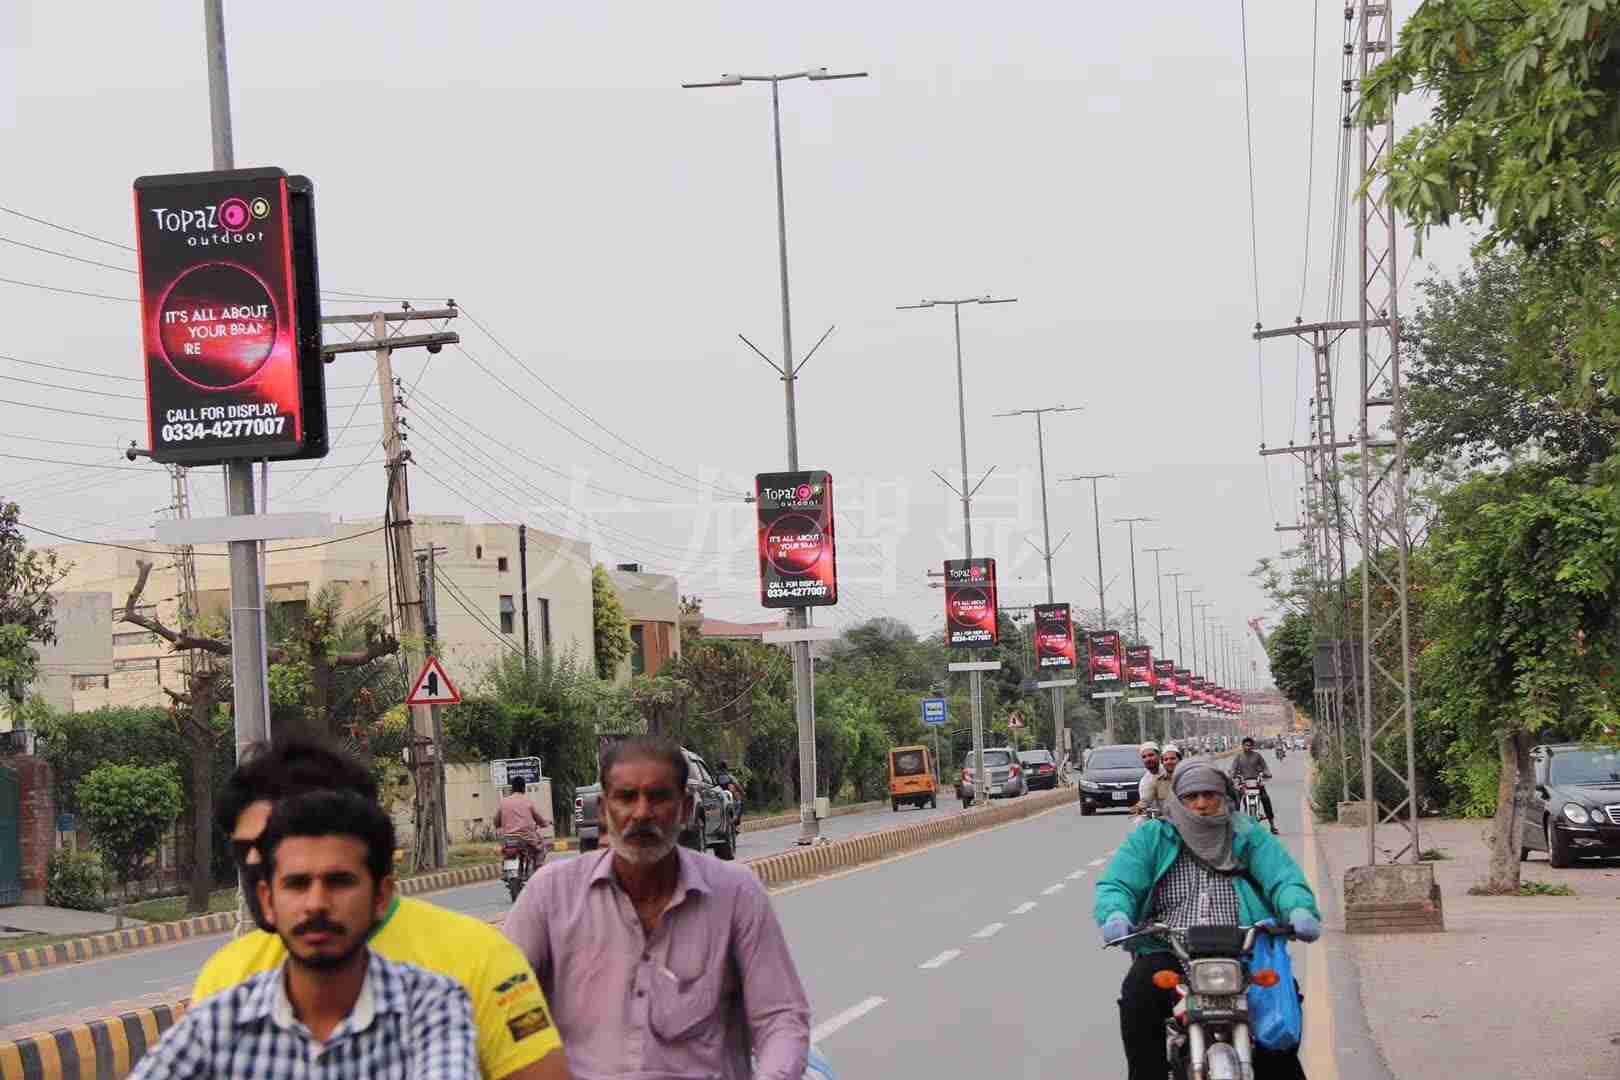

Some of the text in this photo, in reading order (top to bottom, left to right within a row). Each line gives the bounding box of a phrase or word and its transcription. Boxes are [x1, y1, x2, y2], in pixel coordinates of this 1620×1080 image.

[187, 231, 264, 246] outdoor
[165, 304, 268, 324] IT'S ALL ABOUT
[188, 324, 226, 338] YOUR
[166, 403, 279, 423] CALL FOR DISPLAY
[162, 417, 285, 442] 0334-4277007
